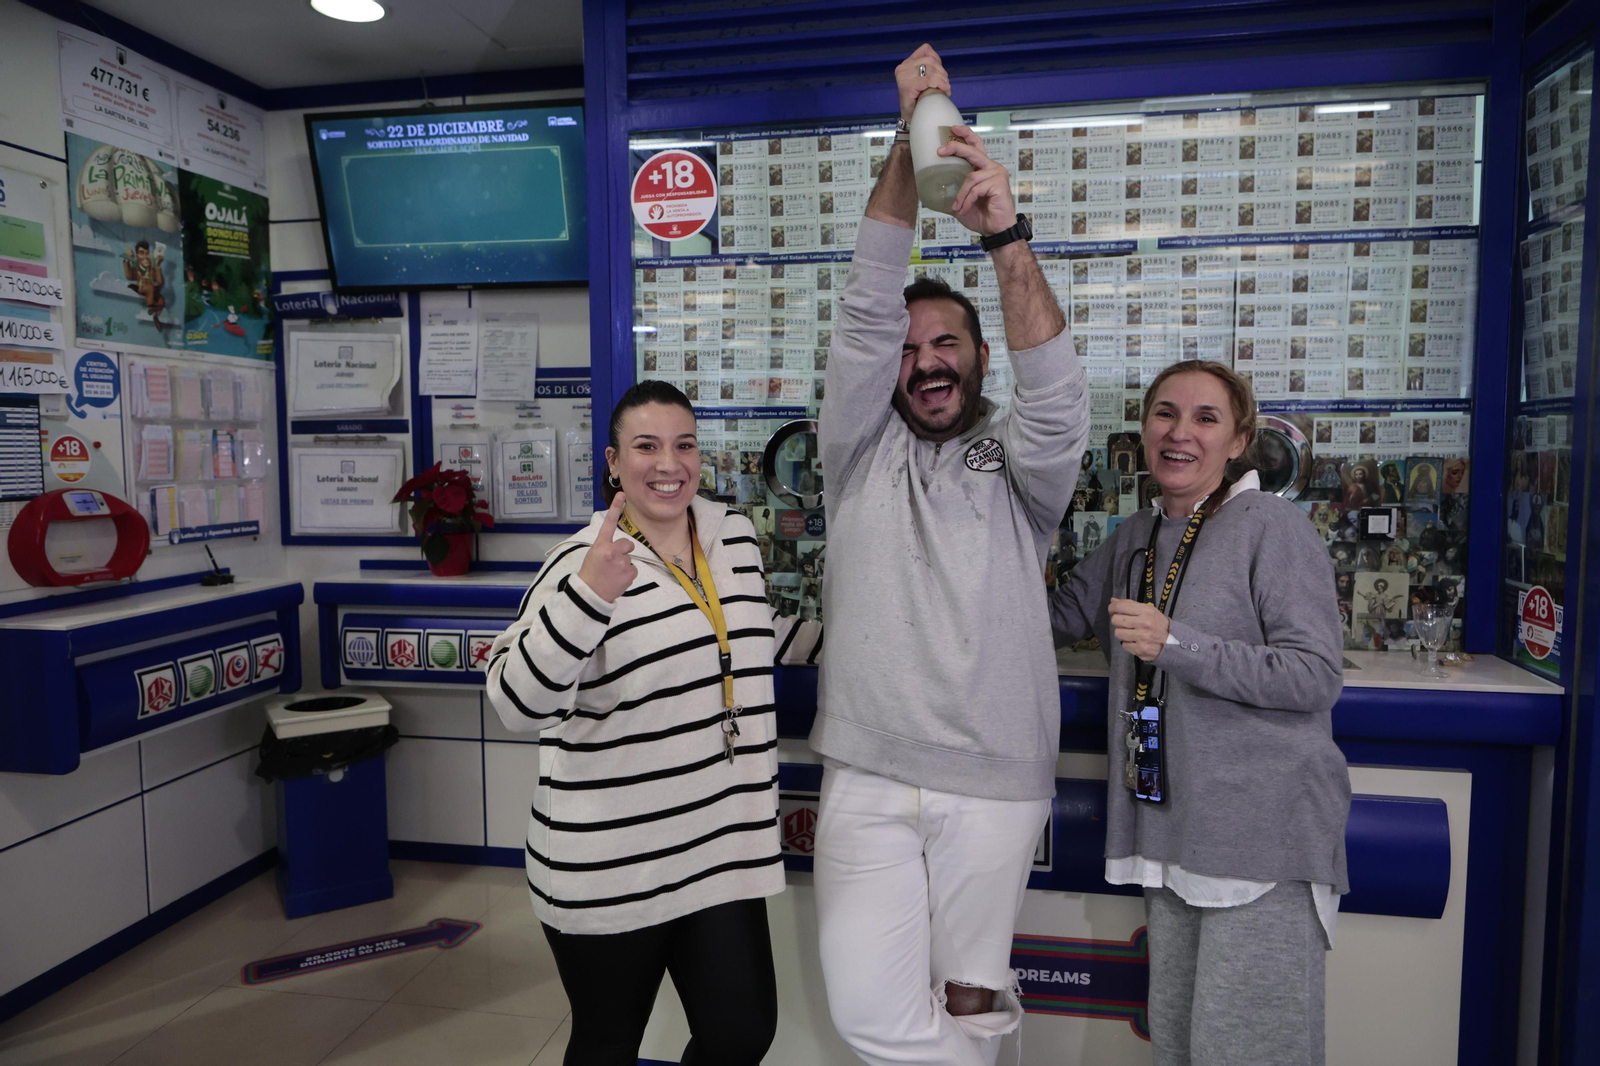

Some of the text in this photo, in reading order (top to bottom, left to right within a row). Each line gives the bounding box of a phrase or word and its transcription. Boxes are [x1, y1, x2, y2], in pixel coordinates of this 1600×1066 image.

[90, 66, 150, 102] 477.731 €
[207, 119, 240, 142] 54.236
[387, 119, 505, 138] 22 DE DICIEMBRE
[367, 133, 530, 150] SORTEO EXTRAORDINARIO DE NAVIDAD
[648, 160, 695, 189] +18
[205, 202, 248, 226] OJALÁ
[345, 360, 377, 369] Nacional
[555, 386, 568, 394] DE
[57, 440, 81, 457] +18
[969, 446, 1003, 467] PEANUTS
[808, 518, 823, 527] +18
[1176, 545, 1186, 559] STOP
[1528, 594, 1548, 619] +18
[299, 953, 356, 968] DURANTE
[375, 941, 406, 952] AÑOS
[305, 948, 356, 962] 20.000€
[375, 939, 399, 949] MES
[1016, 968, 1091, 985] DREAMS
